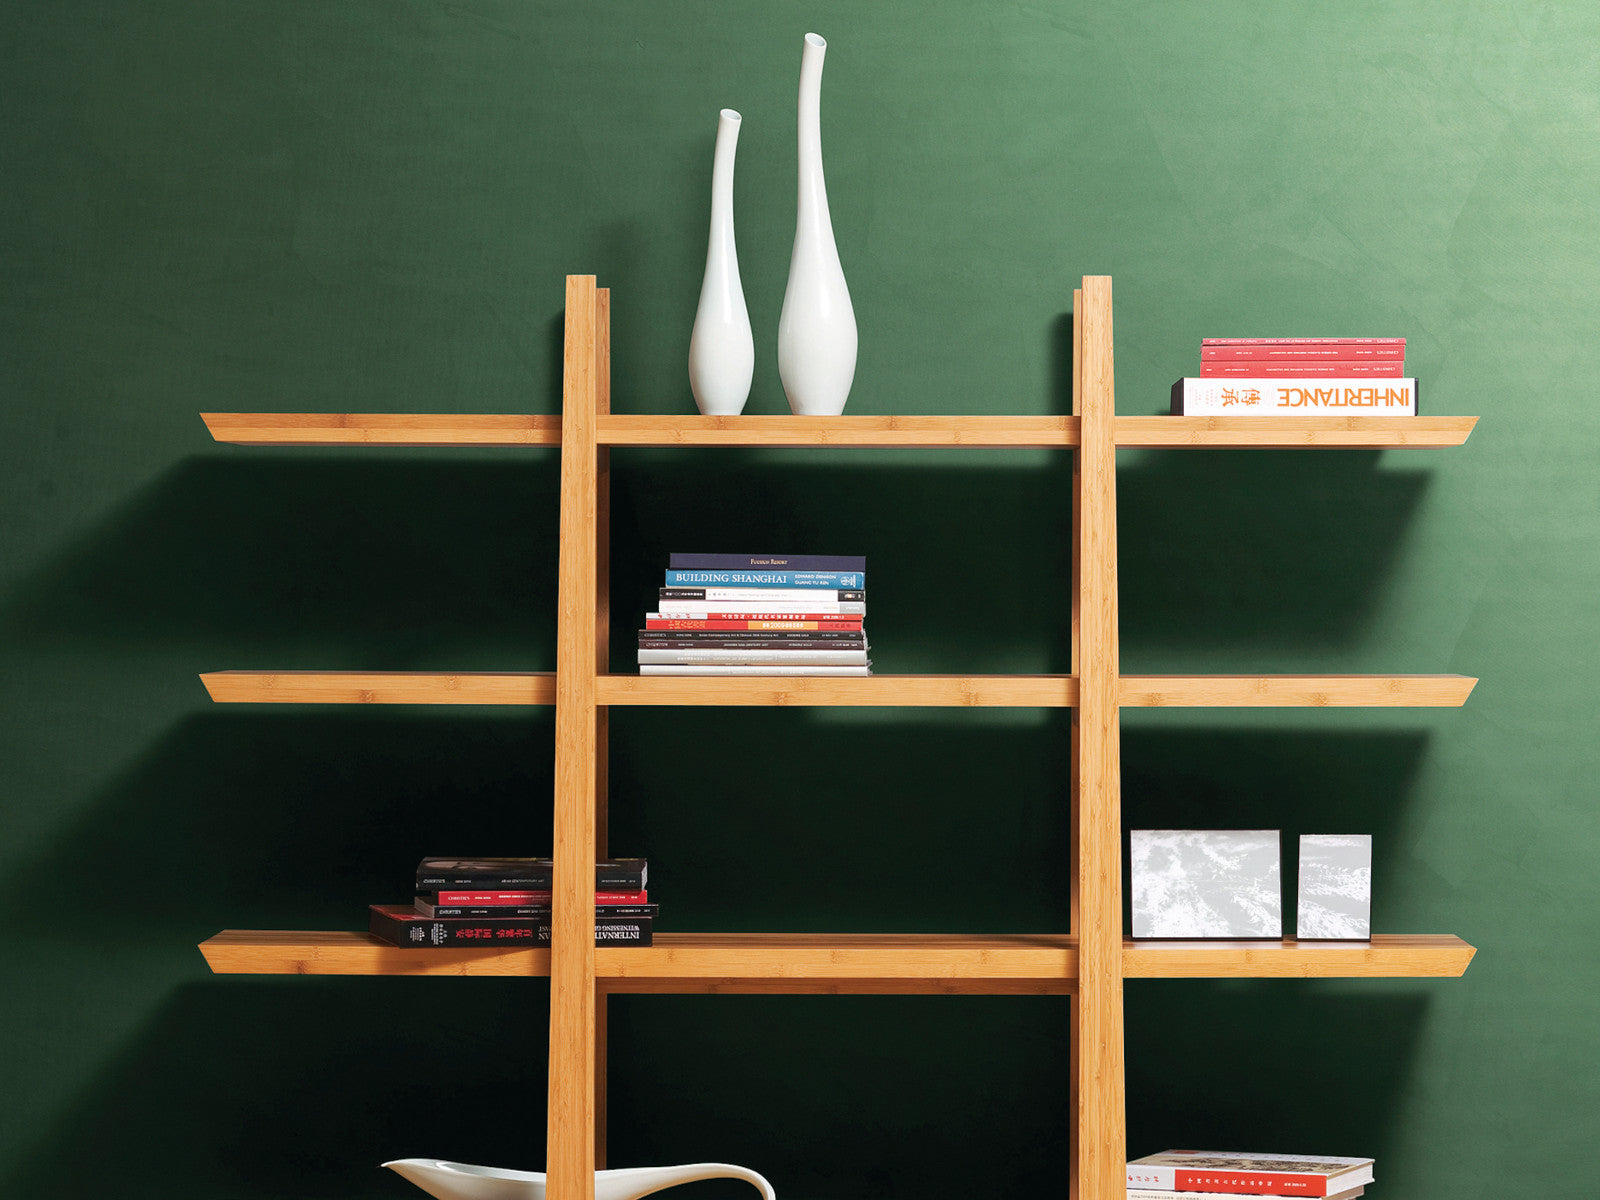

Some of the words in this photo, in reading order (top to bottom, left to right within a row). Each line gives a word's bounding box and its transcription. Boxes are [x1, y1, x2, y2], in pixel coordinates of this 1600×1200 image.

[1221, 387, 1261, 407] 傳承
[1277, 388, 1409, 406] INHERITANCE
[676, 573, 729, 582] BUILDING
[732, 574, 787, 584] SHANGHAI
